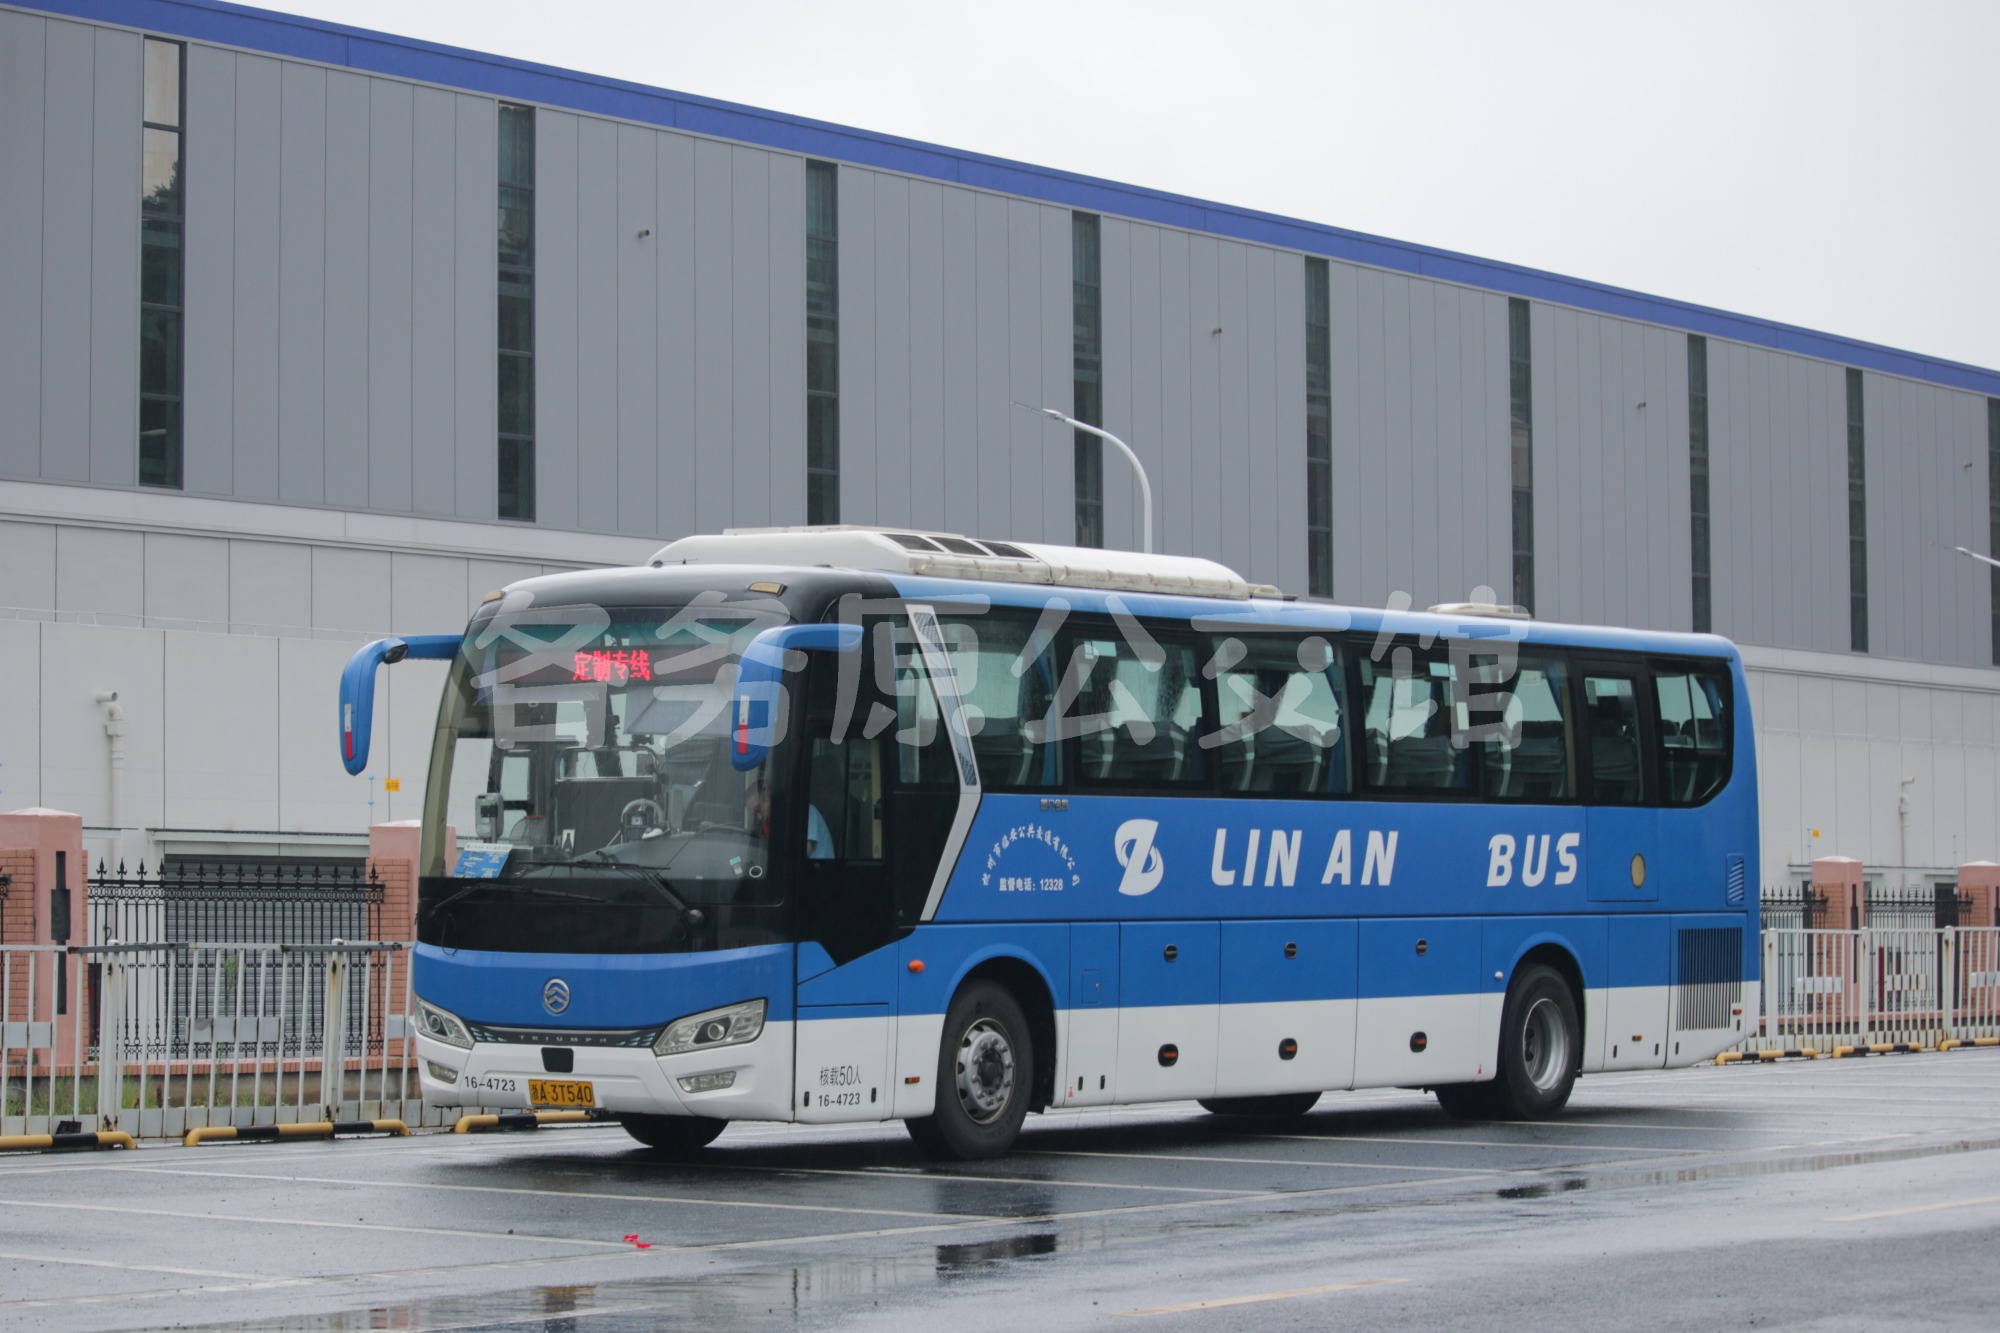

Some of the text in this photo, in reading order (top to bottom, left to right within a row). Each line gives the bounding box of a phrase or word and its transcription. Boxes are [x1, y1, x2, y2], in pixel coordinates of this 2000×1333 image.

[572, 649, 651, 682] 定制专线
[1211, 828, 1580, 888] LIN AN BUS
[519, 1035, 607, 1043] TRIUMPH
[465, 1076, 516, 1092] 16-4723
[819, 1065, 862, 1086] 核载50人
[818, 1093, 861, 1107] 16-4723
